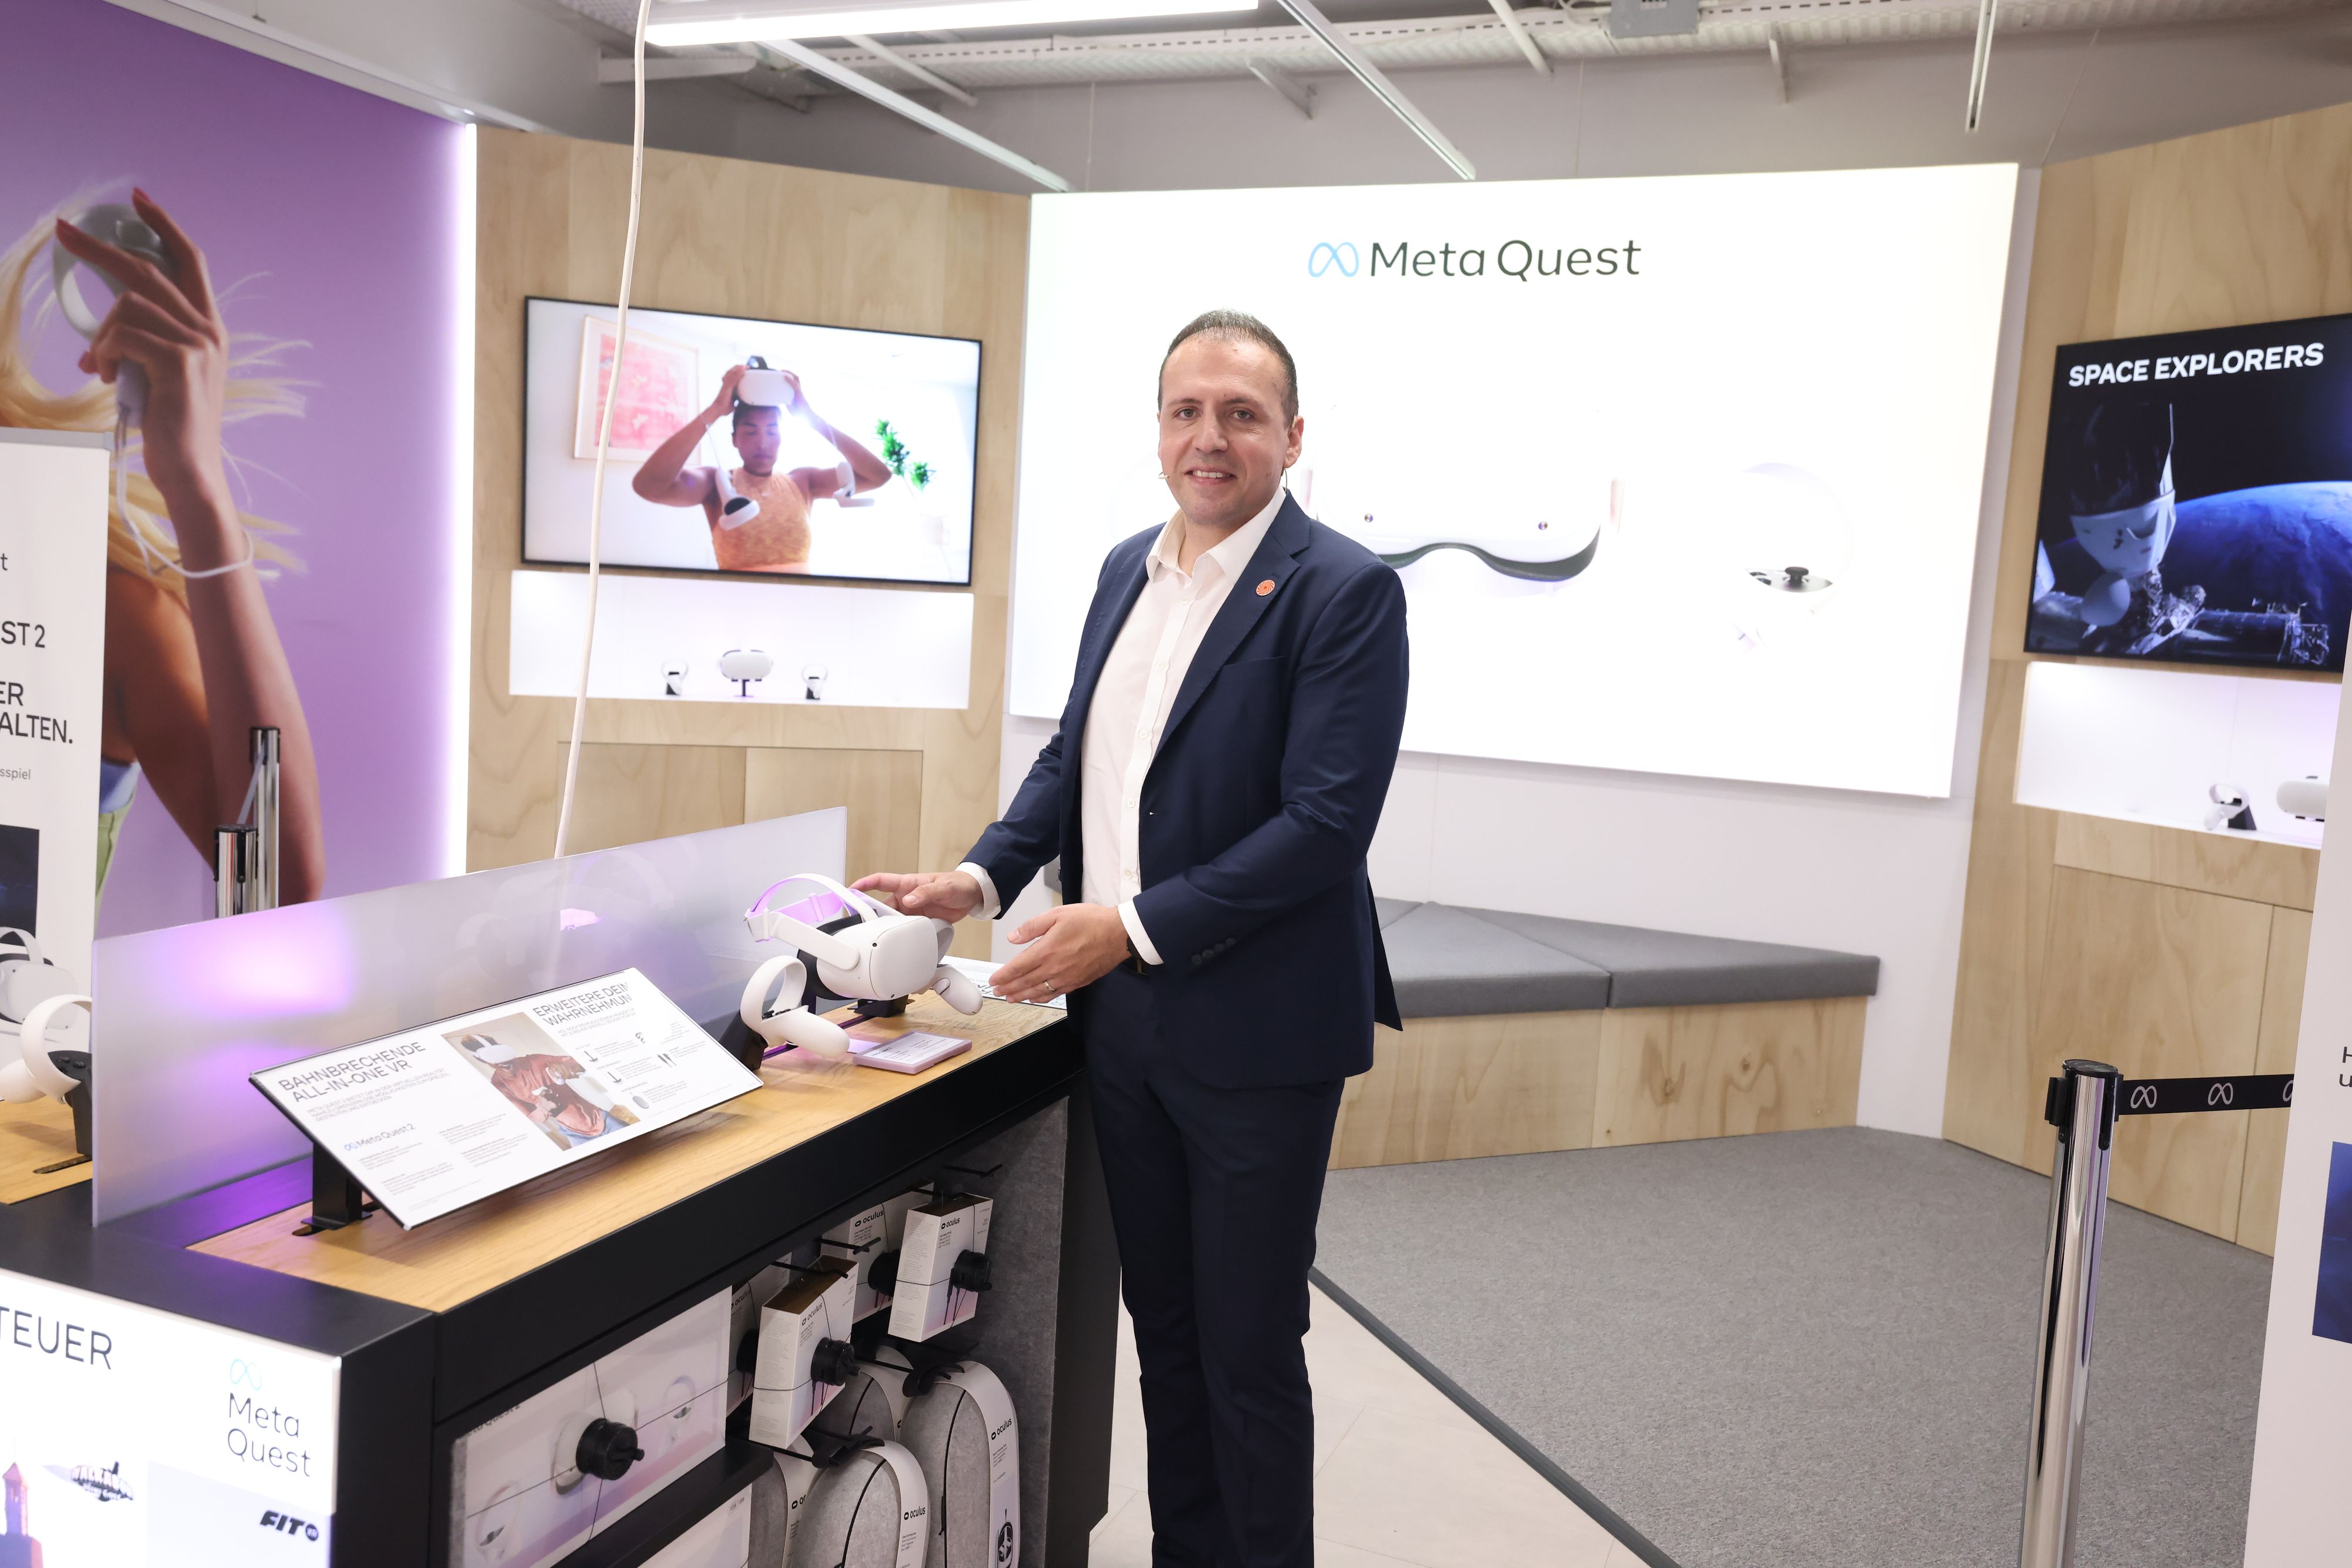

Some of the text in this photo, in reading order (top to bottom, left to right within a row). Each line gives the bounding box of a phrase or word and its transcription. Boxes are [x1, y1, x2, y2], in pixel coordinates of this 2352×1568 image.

[1371, 239, 1642, 282] Meta Quest
[2068, 343, 2324, 387] SPACE EXPLORERS
[35, 624, 46, 648] 2
[533, 990, 602, 1017] ERWEITERE
[278, 1042, 426, 1091] BAHNBRECHENDE
[292, 1060, 413, 1102] ALL-IN-ONE VR
[356, 1135, 382, 1147] Meta
[381, 1126, 409, 1139] Quest
[863, 1210, 884, 1223] oculus
[946, 1217, 960, 1228] oculus
[807, 1302, 823, 1320] oculus
[229, 1392, 300, 1438] Meta
[997, 1418, 1012, 1436] oculus
[228, 1428, 312, 1477] Quest
[260, 1510, 305, 1536] FIT
[910, 1506, 926, 1518] oculus
